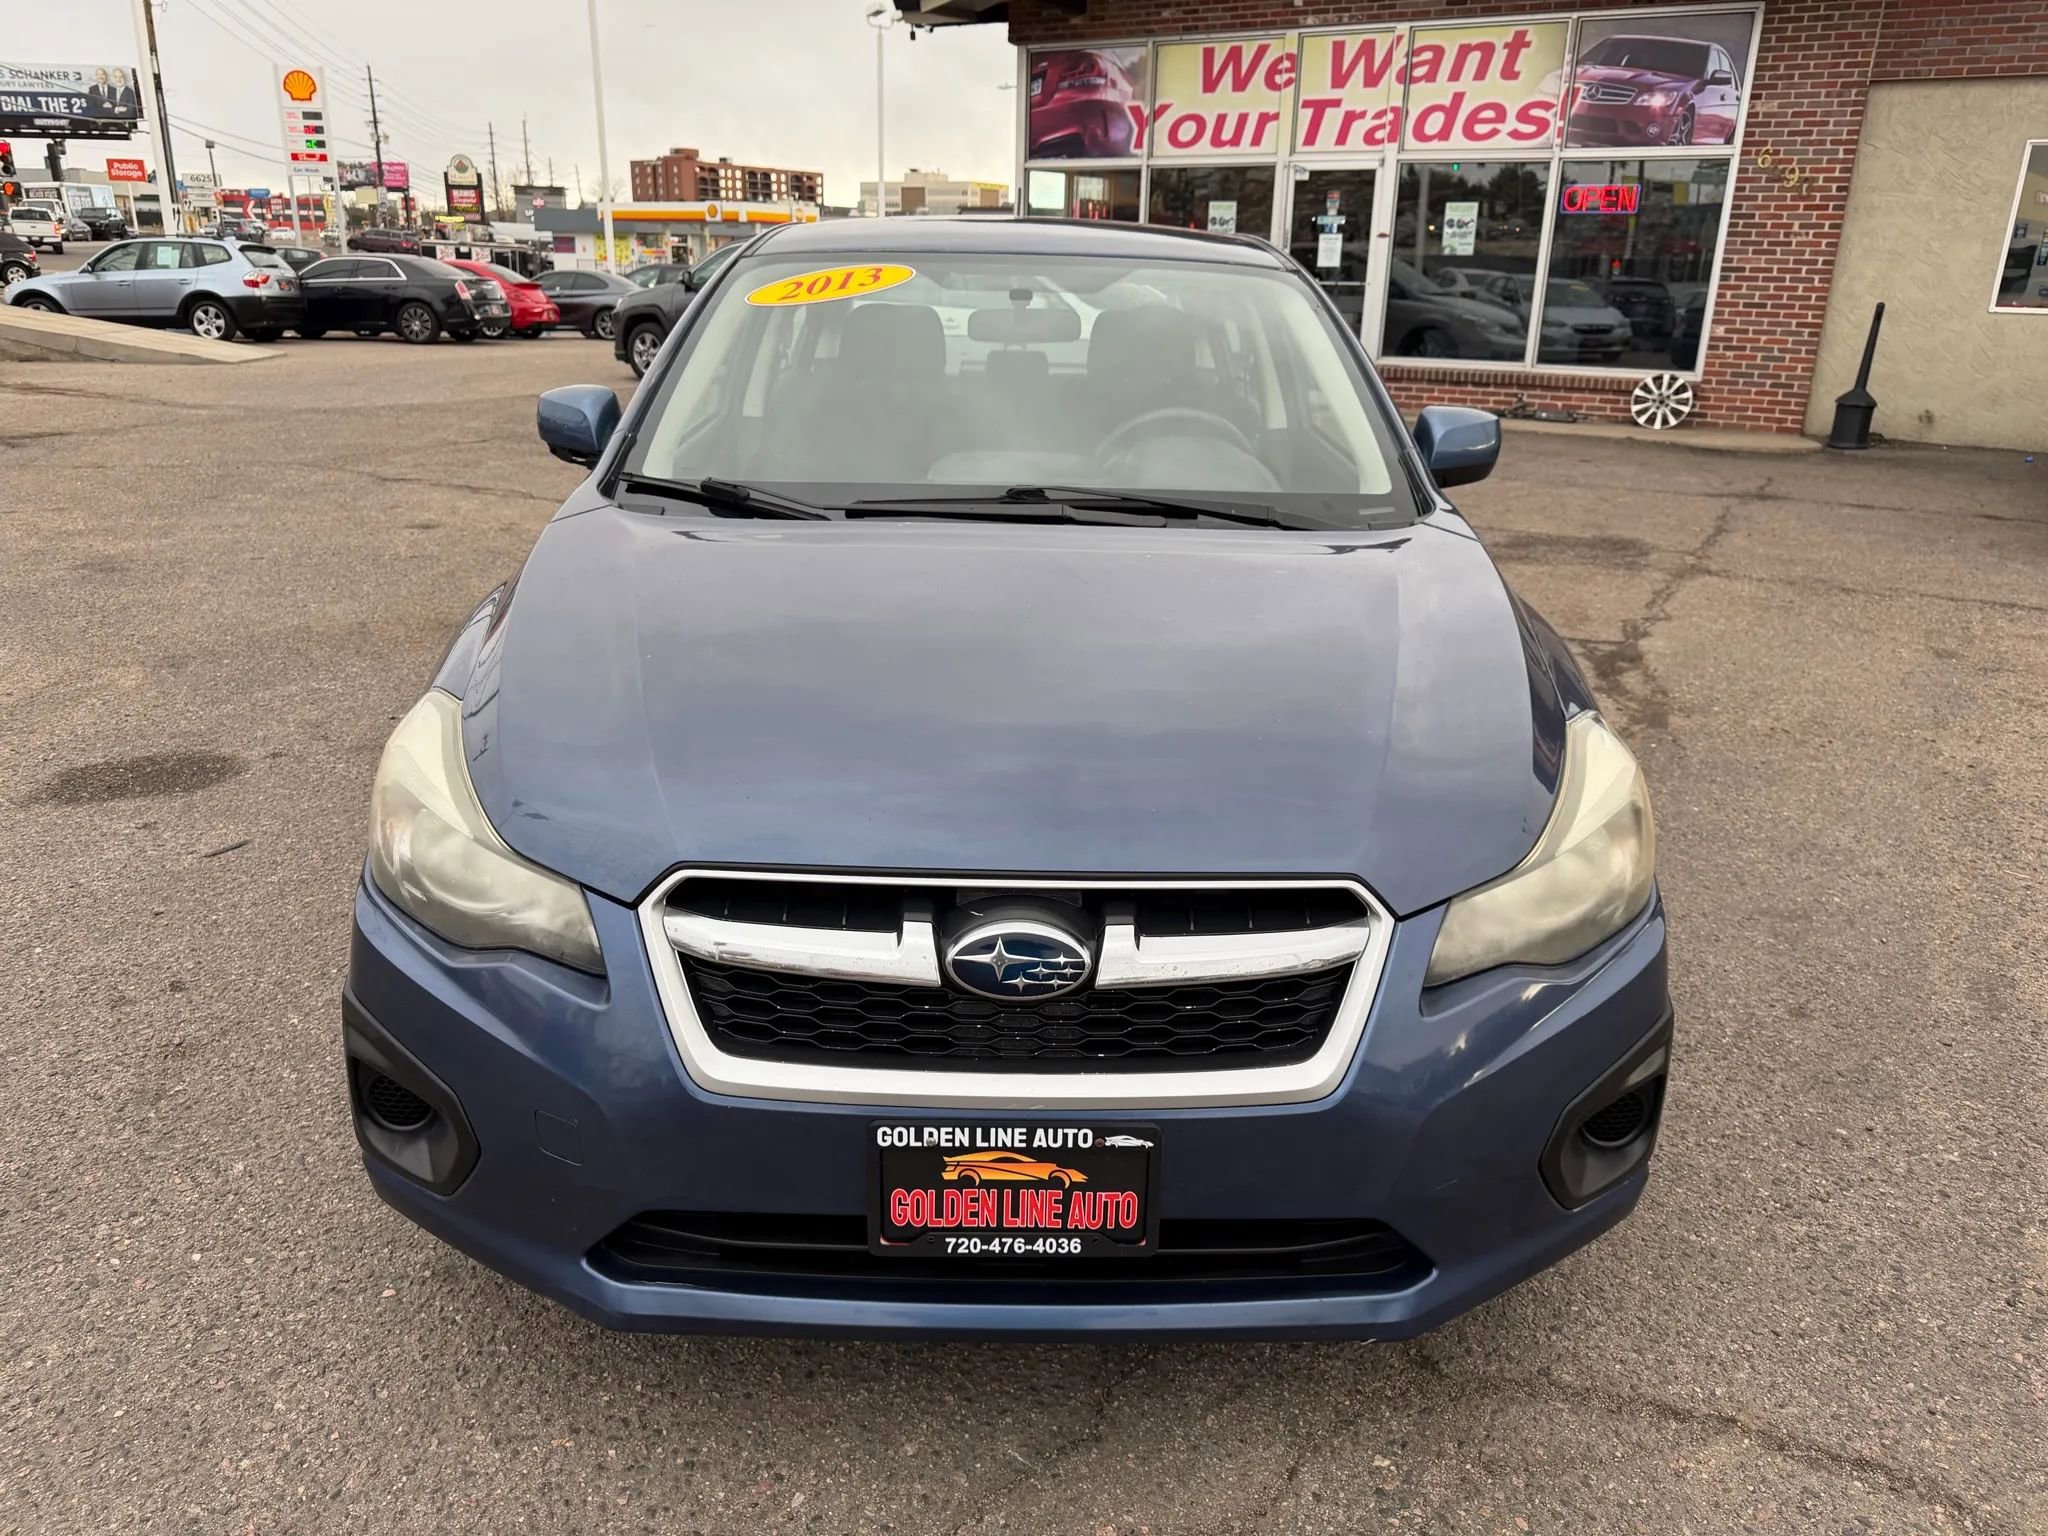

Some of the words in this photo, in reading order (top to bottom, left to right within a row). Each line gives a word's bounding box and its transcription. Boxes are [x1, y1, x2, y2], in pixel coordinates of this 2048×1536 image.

[1202, 43, 1297, 94] We
[1330, 29, 1533, 90] Want
[9, 69, 70, 81] SCHANKER
[0, 96, 37, 112] DIAL
[37, 97, 70, 113] THE
[1127, 103, 1280, 150] Your
[1301, 87, 1581, 148] Trades!
[110, 168, 143, 179] Storage
[113, 161, 139, 169] Public
[1563, 185, 1638, 212] OPEN
[776, 267, 883, 302] 2013
[876, 1126, 970, 1148] GOLDEN
[976, 1127, 1029, 1148] LINE
[1033, 1128, 1093, 1149] AUTO
[890, 1188, 998, 1228] GOLDEN
[1003, 1189, 1063, 1229] LINE
[1067, 1191, 1139, 1230] AUTO
[945, 1237, 1082, 1255] 720-476-4036
